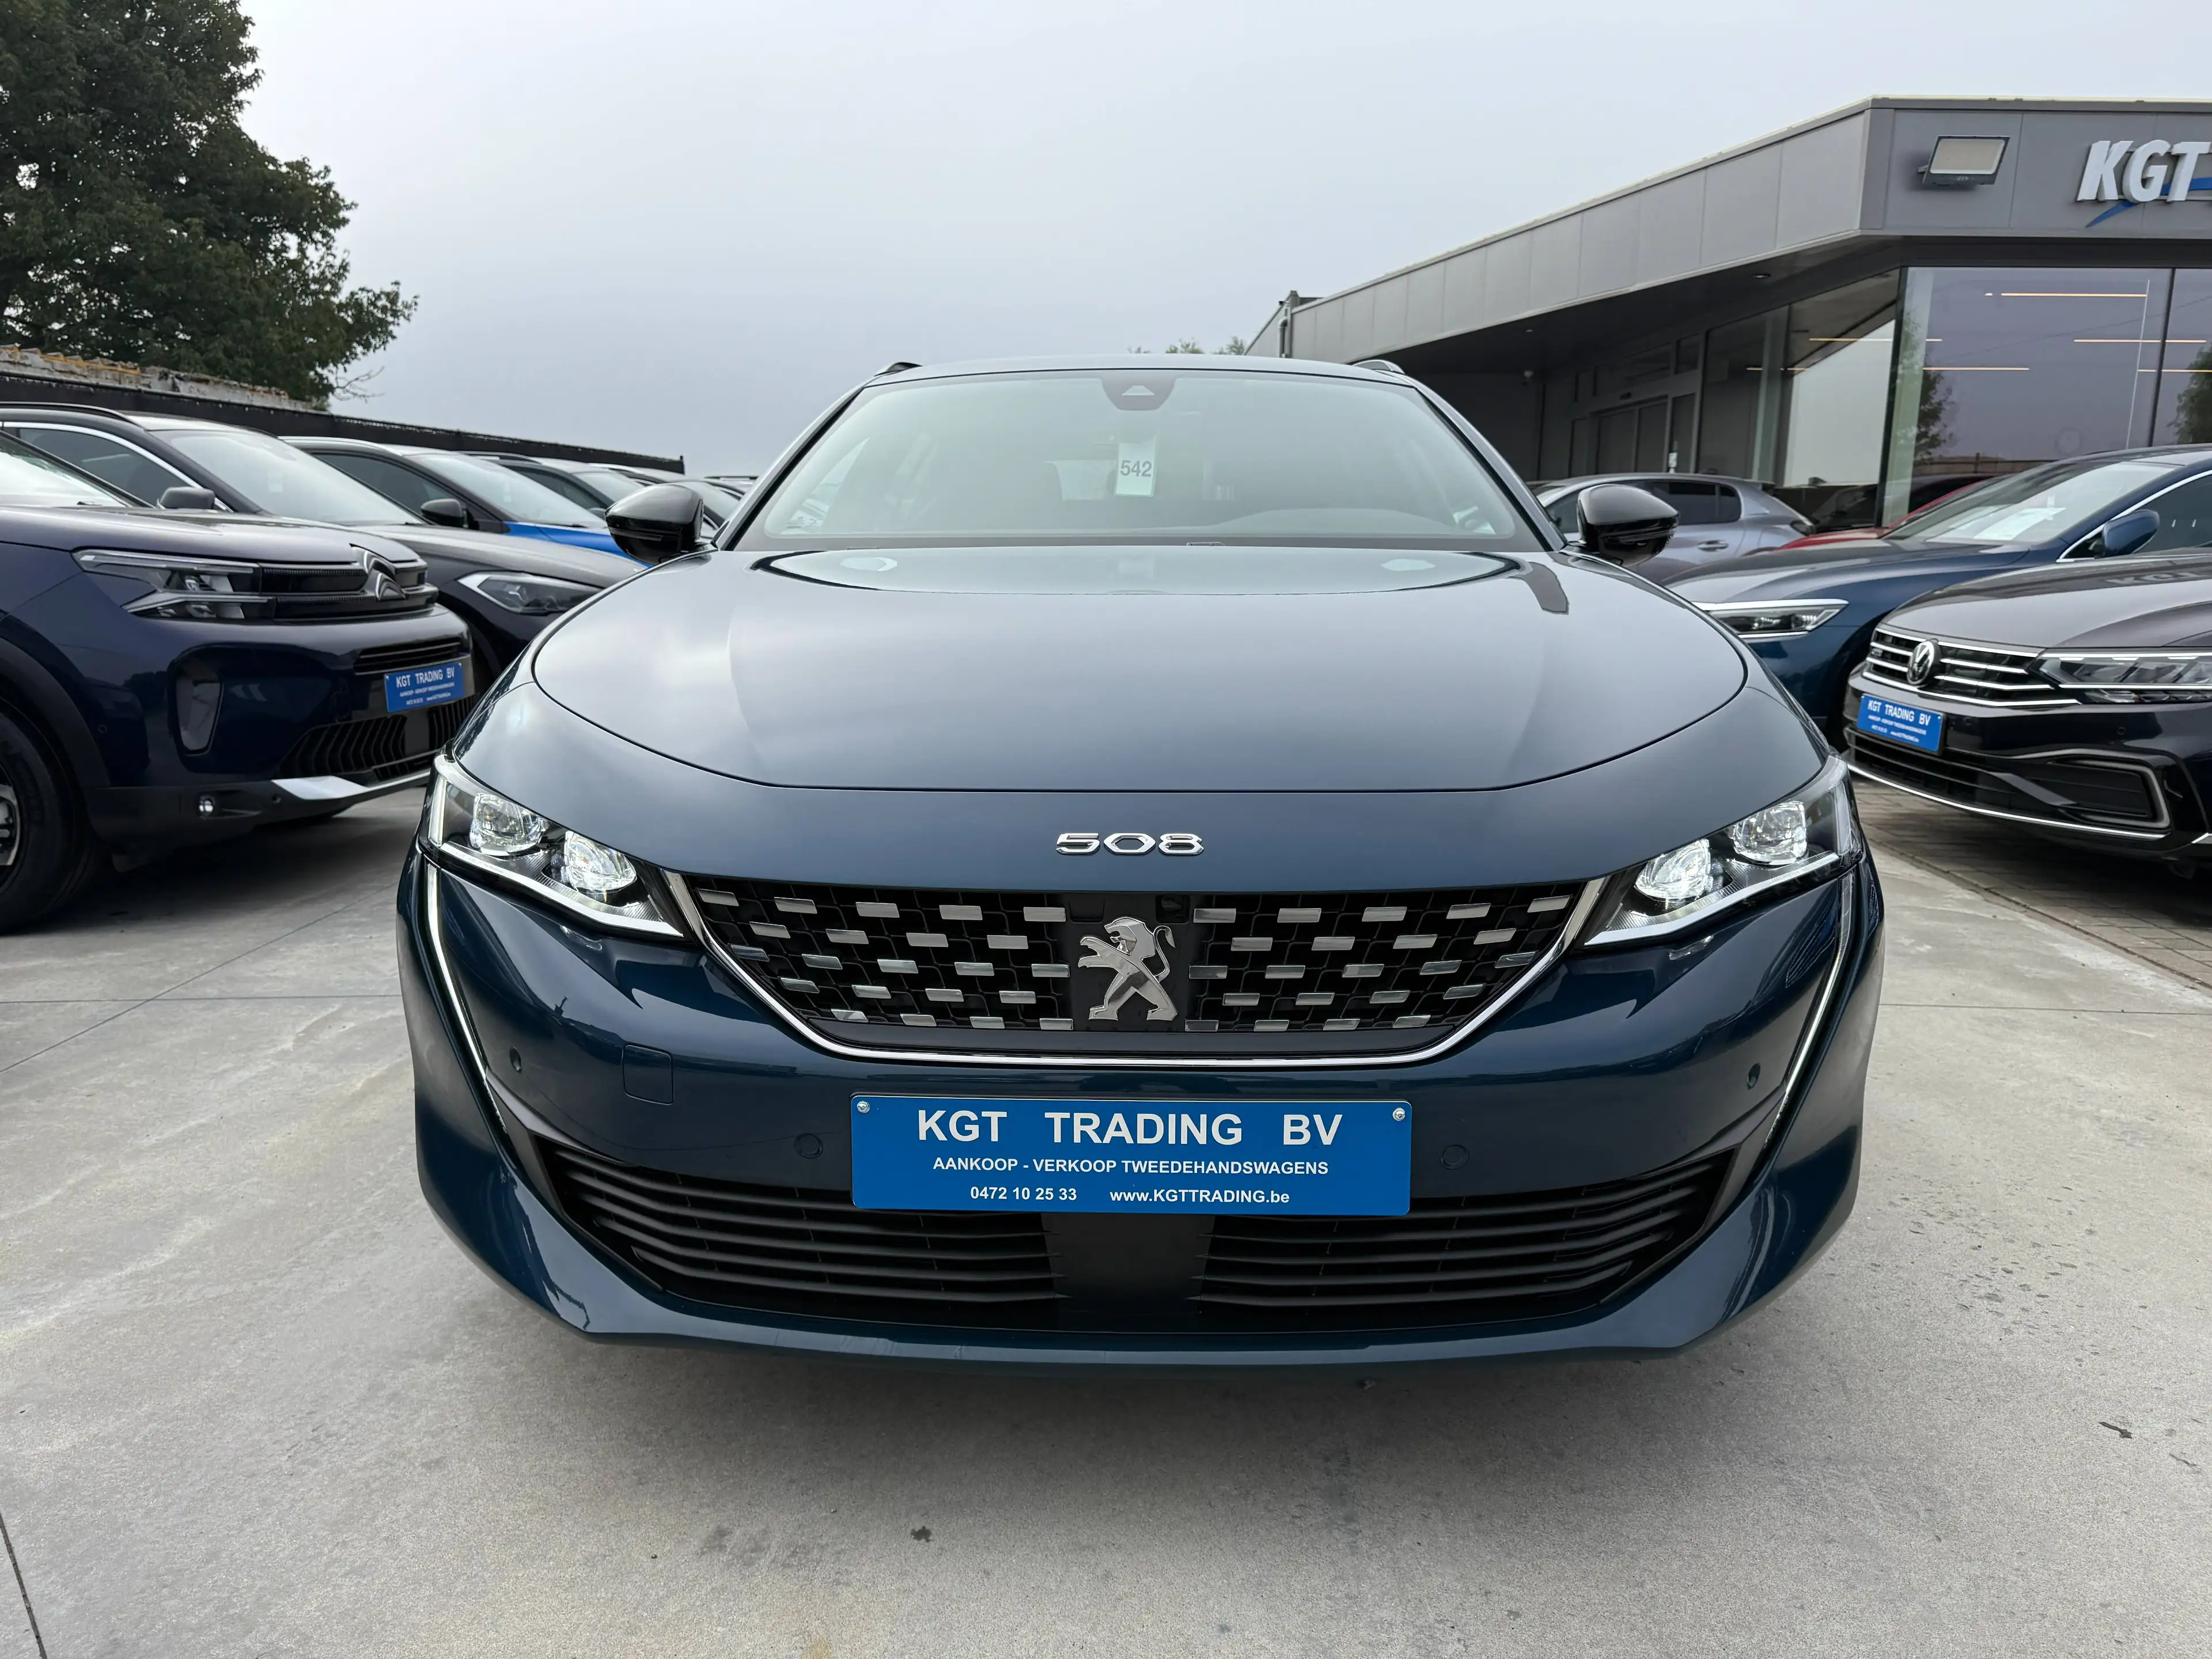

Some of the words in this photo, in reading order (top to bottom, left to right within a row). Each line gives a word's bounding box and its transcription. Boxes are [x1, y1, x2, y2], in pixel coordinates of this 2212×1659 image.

[2077, 140, 2211, 202] KGT
[1120, 460, 1152, 477] 542
[396, 675, 411, 688] KGT
[415, 669, 444, 684] TRADING
[446, 666, 455, 679] BV
[1868, 700, 1882, 713] KGT
[1885, 704, 1915, 722] TRADING
[1919, 713, 1931, 726] BV
[1056, 832, 1205, 855] 508
[918, 1109, 1007, 1142] KGT
[1044, 1112, 1242, 1145] TRADING
[1283, 1114, 1343, 1145] BV
[933, 1157, 1018, 1171] AANKOOP
[1032, 1158, 1117, 1173] VERKOOP
[1121, 1160, 1328, 1175] TWEEDEHANDSWAGENS
[970, 1186, 1007, 1199] 0472
[1013, 1187, 1030, 1200] 10
[1035, 1187, 1054, 1200] 25
[1059, 1188, 1077, 1200] 33
[1109, 1189, 1290, 1203] www.KGTTRADING.be
